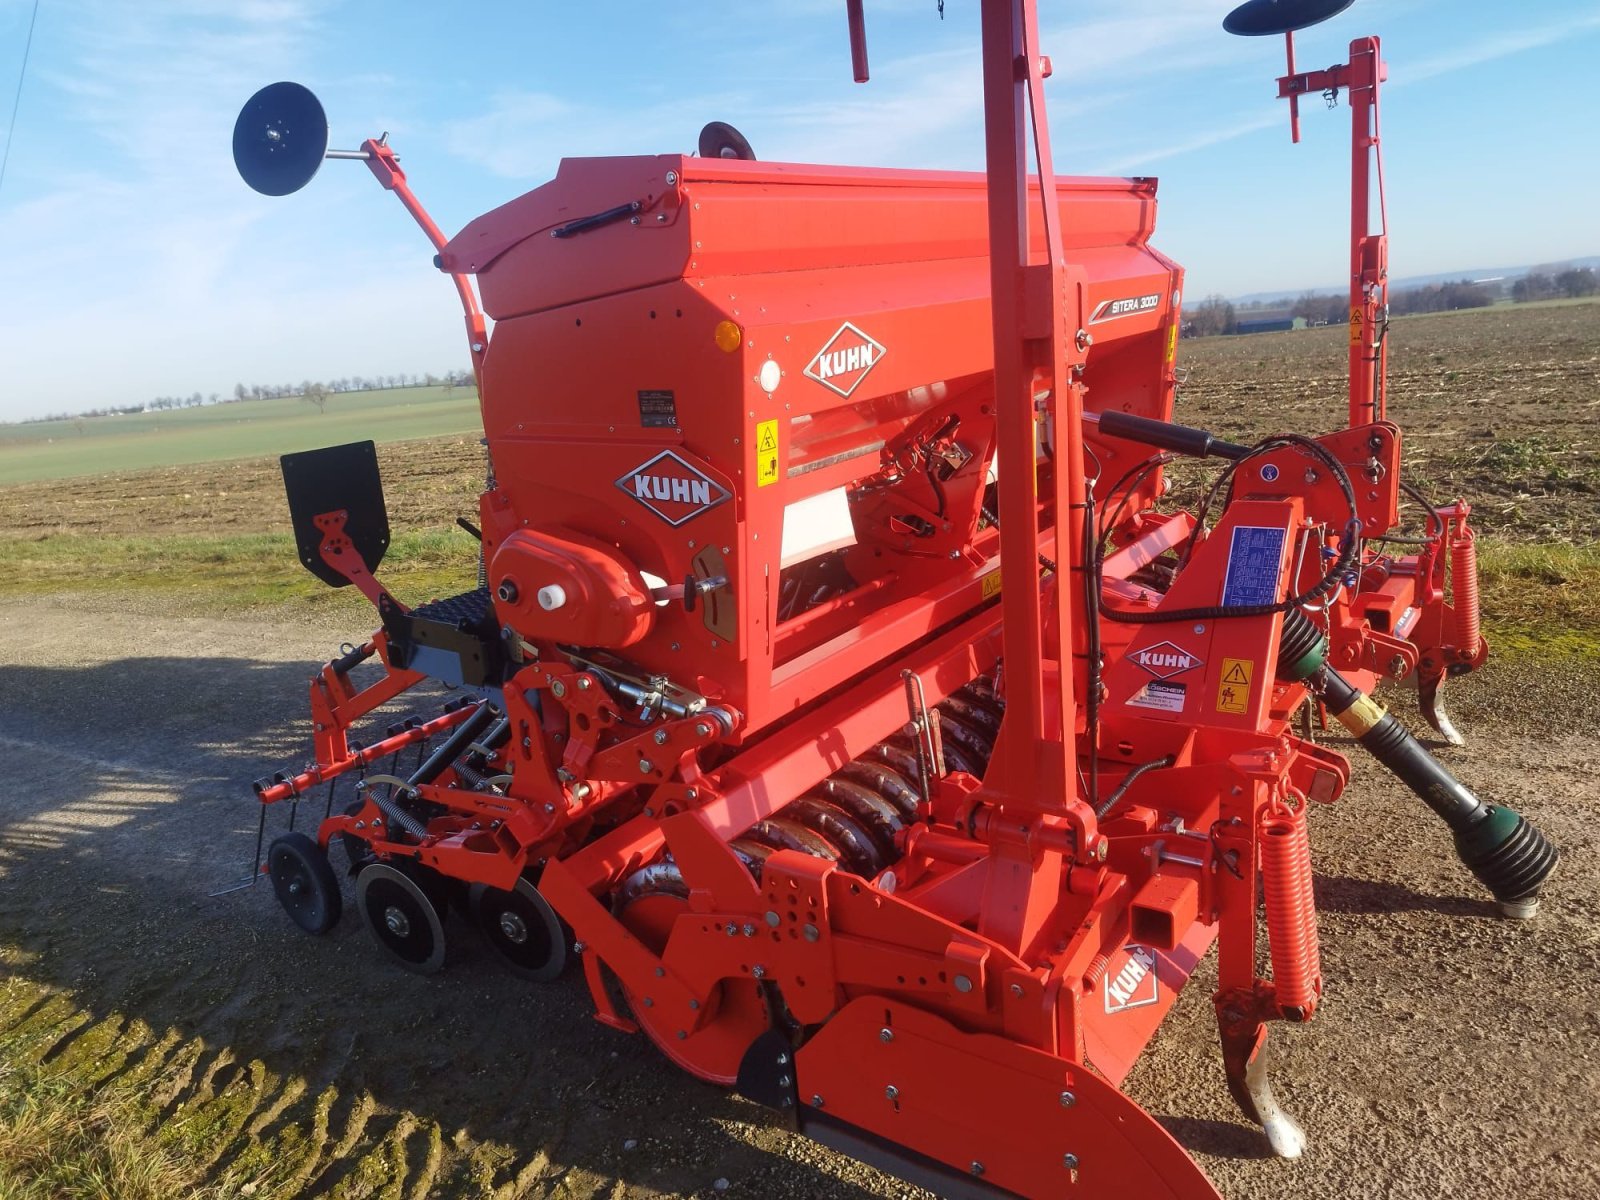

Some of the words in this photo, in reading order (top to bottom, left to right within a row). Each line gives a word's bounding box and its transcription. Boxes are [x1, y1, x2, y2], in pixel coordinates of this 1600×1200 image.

[1112, 299, 1138, 314] SITERA
[1140, 295, 1158, 309] 3000
[820, 343, 873, 379] KUHN
[634, 474, 711, 505] KUHN
[1139, 652, 1191, 668] KUHN
[1108, 947, 1154, 1006] KUHN
